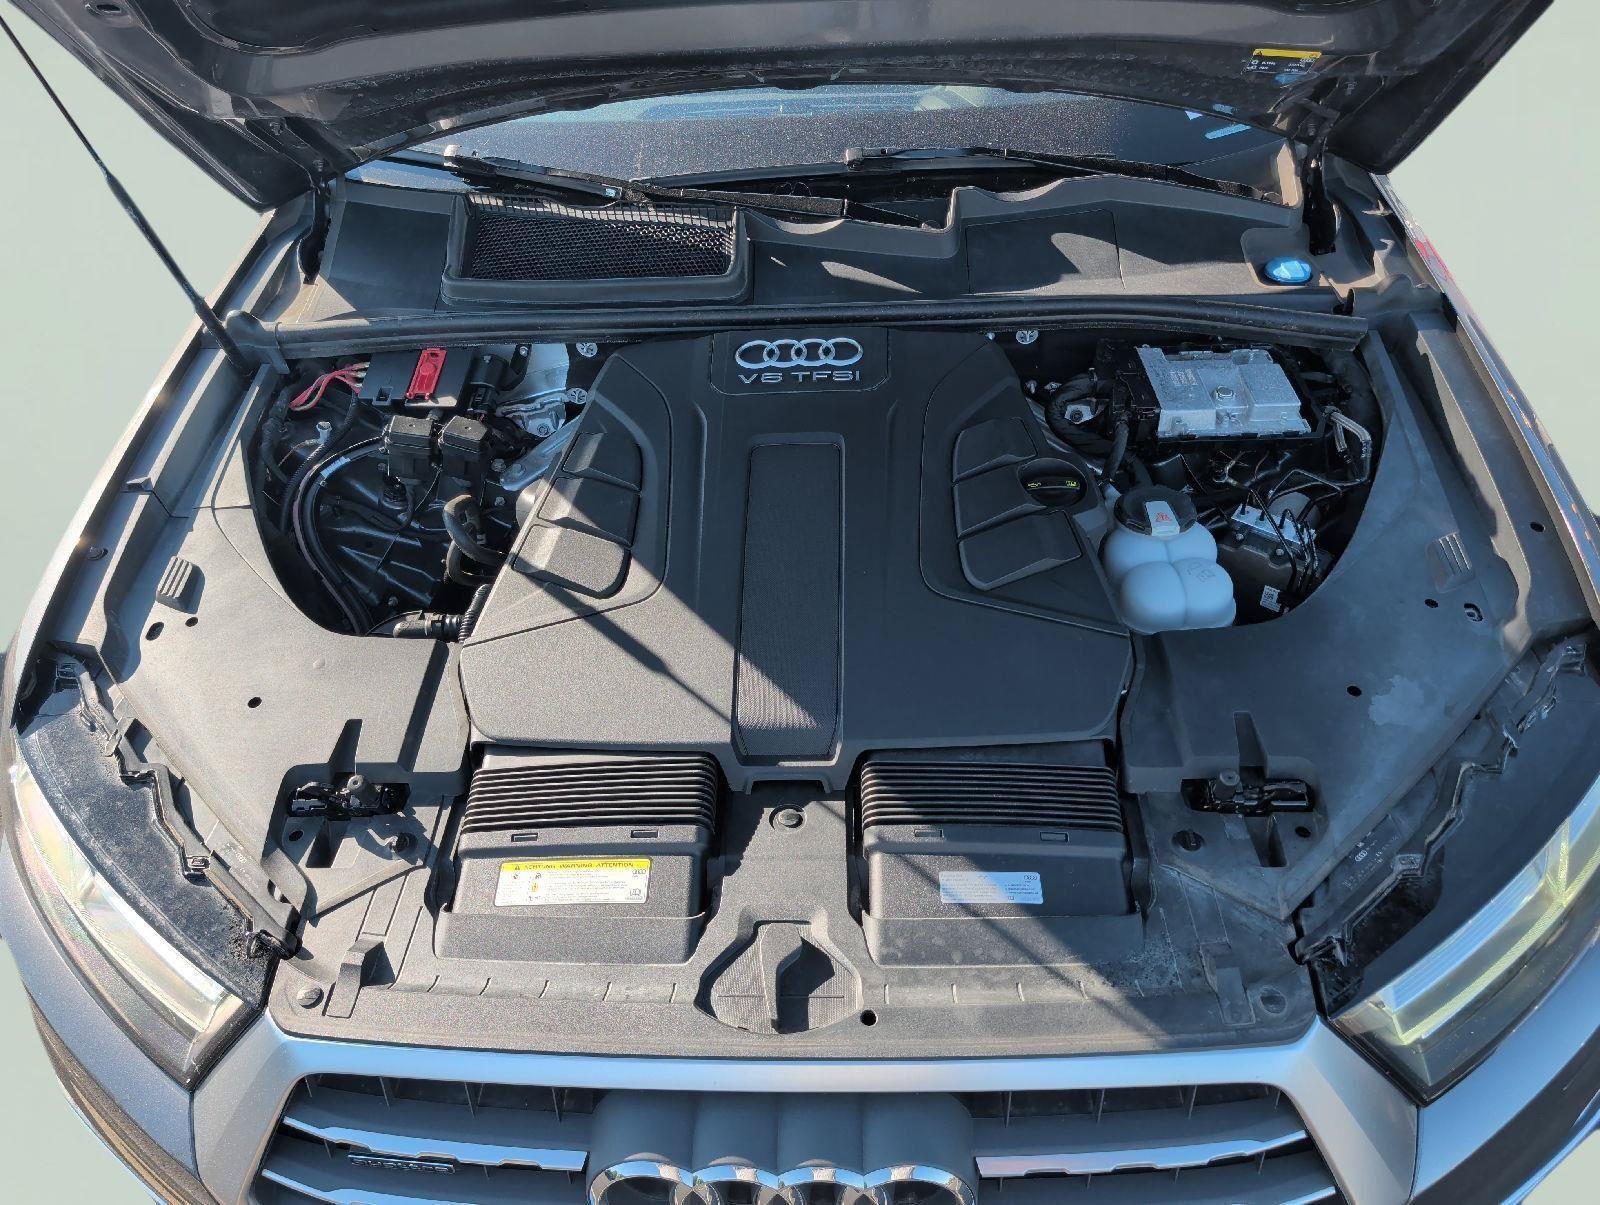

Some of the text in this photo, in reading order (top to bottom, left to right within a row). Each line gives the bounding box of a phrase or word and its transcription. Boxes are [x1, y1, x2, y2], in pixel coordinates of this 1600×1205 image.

[738, 370, 860, 384] V6 TFSI
[595, 861, 634, 869] ATTENTION
